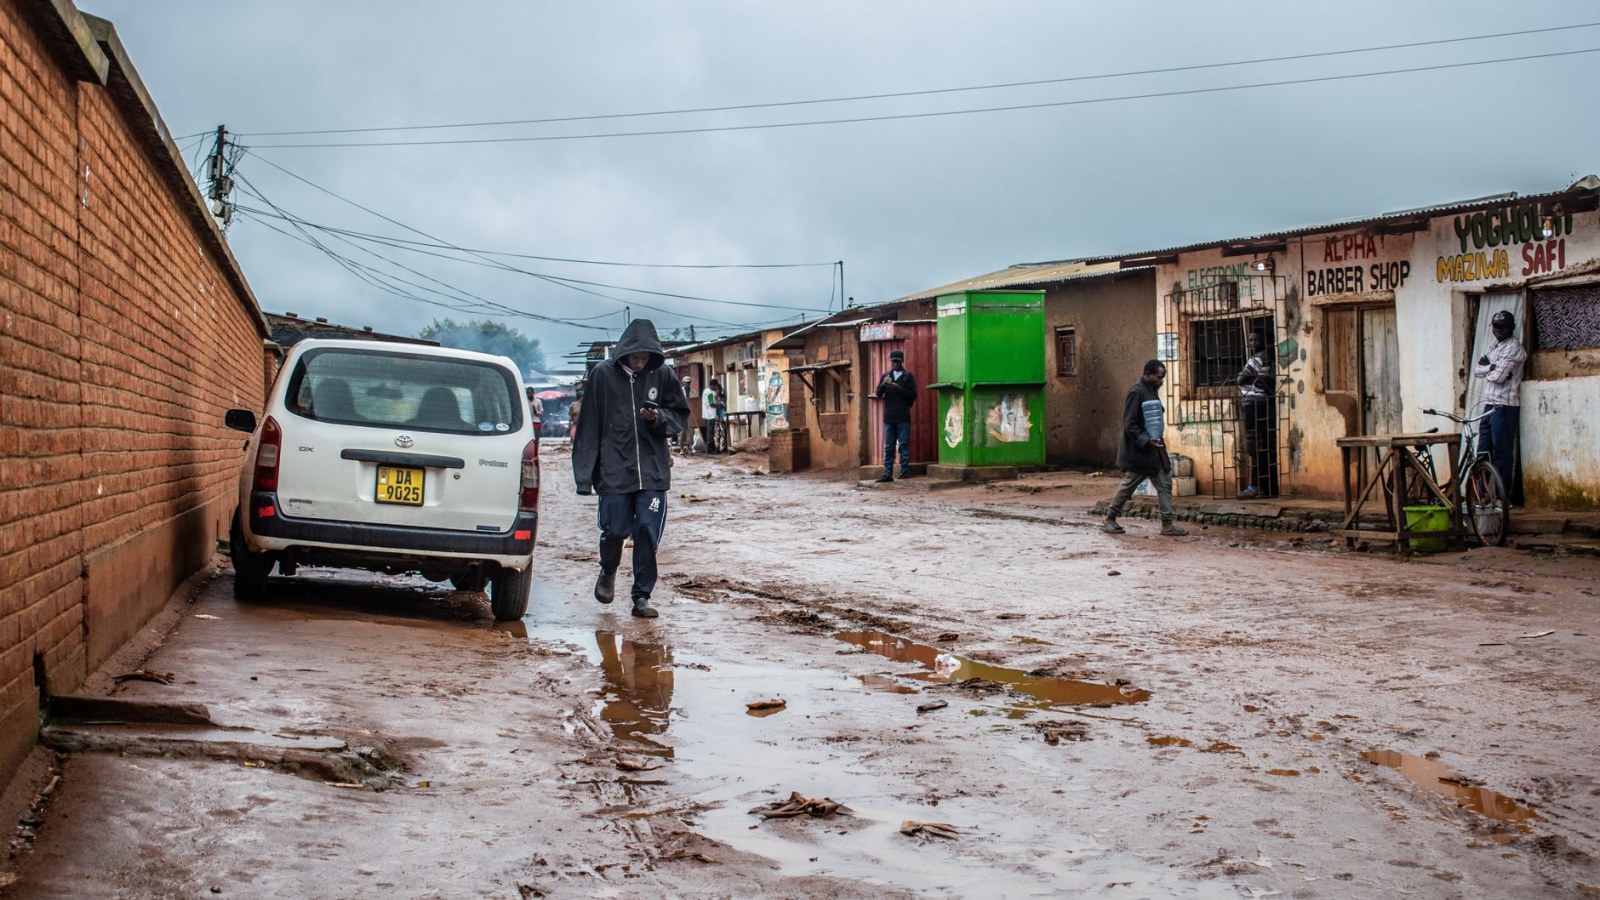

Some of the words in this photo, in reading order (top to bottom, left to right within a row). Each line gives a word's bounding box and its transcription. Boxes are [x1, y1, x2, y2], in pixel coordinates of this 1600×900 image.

[1324, 234, 1377, 262] ALPHA
[1437, 249, 1509, 283] MAZIWA
[1522, 239, 1566, 276] SAFI
[1308, 266, 1363, 296] BARBER
[1370, 260, 1411, 290] SHOP
[395, 470, 412, 485] DA
[387, 485, 420, 502] 9025
